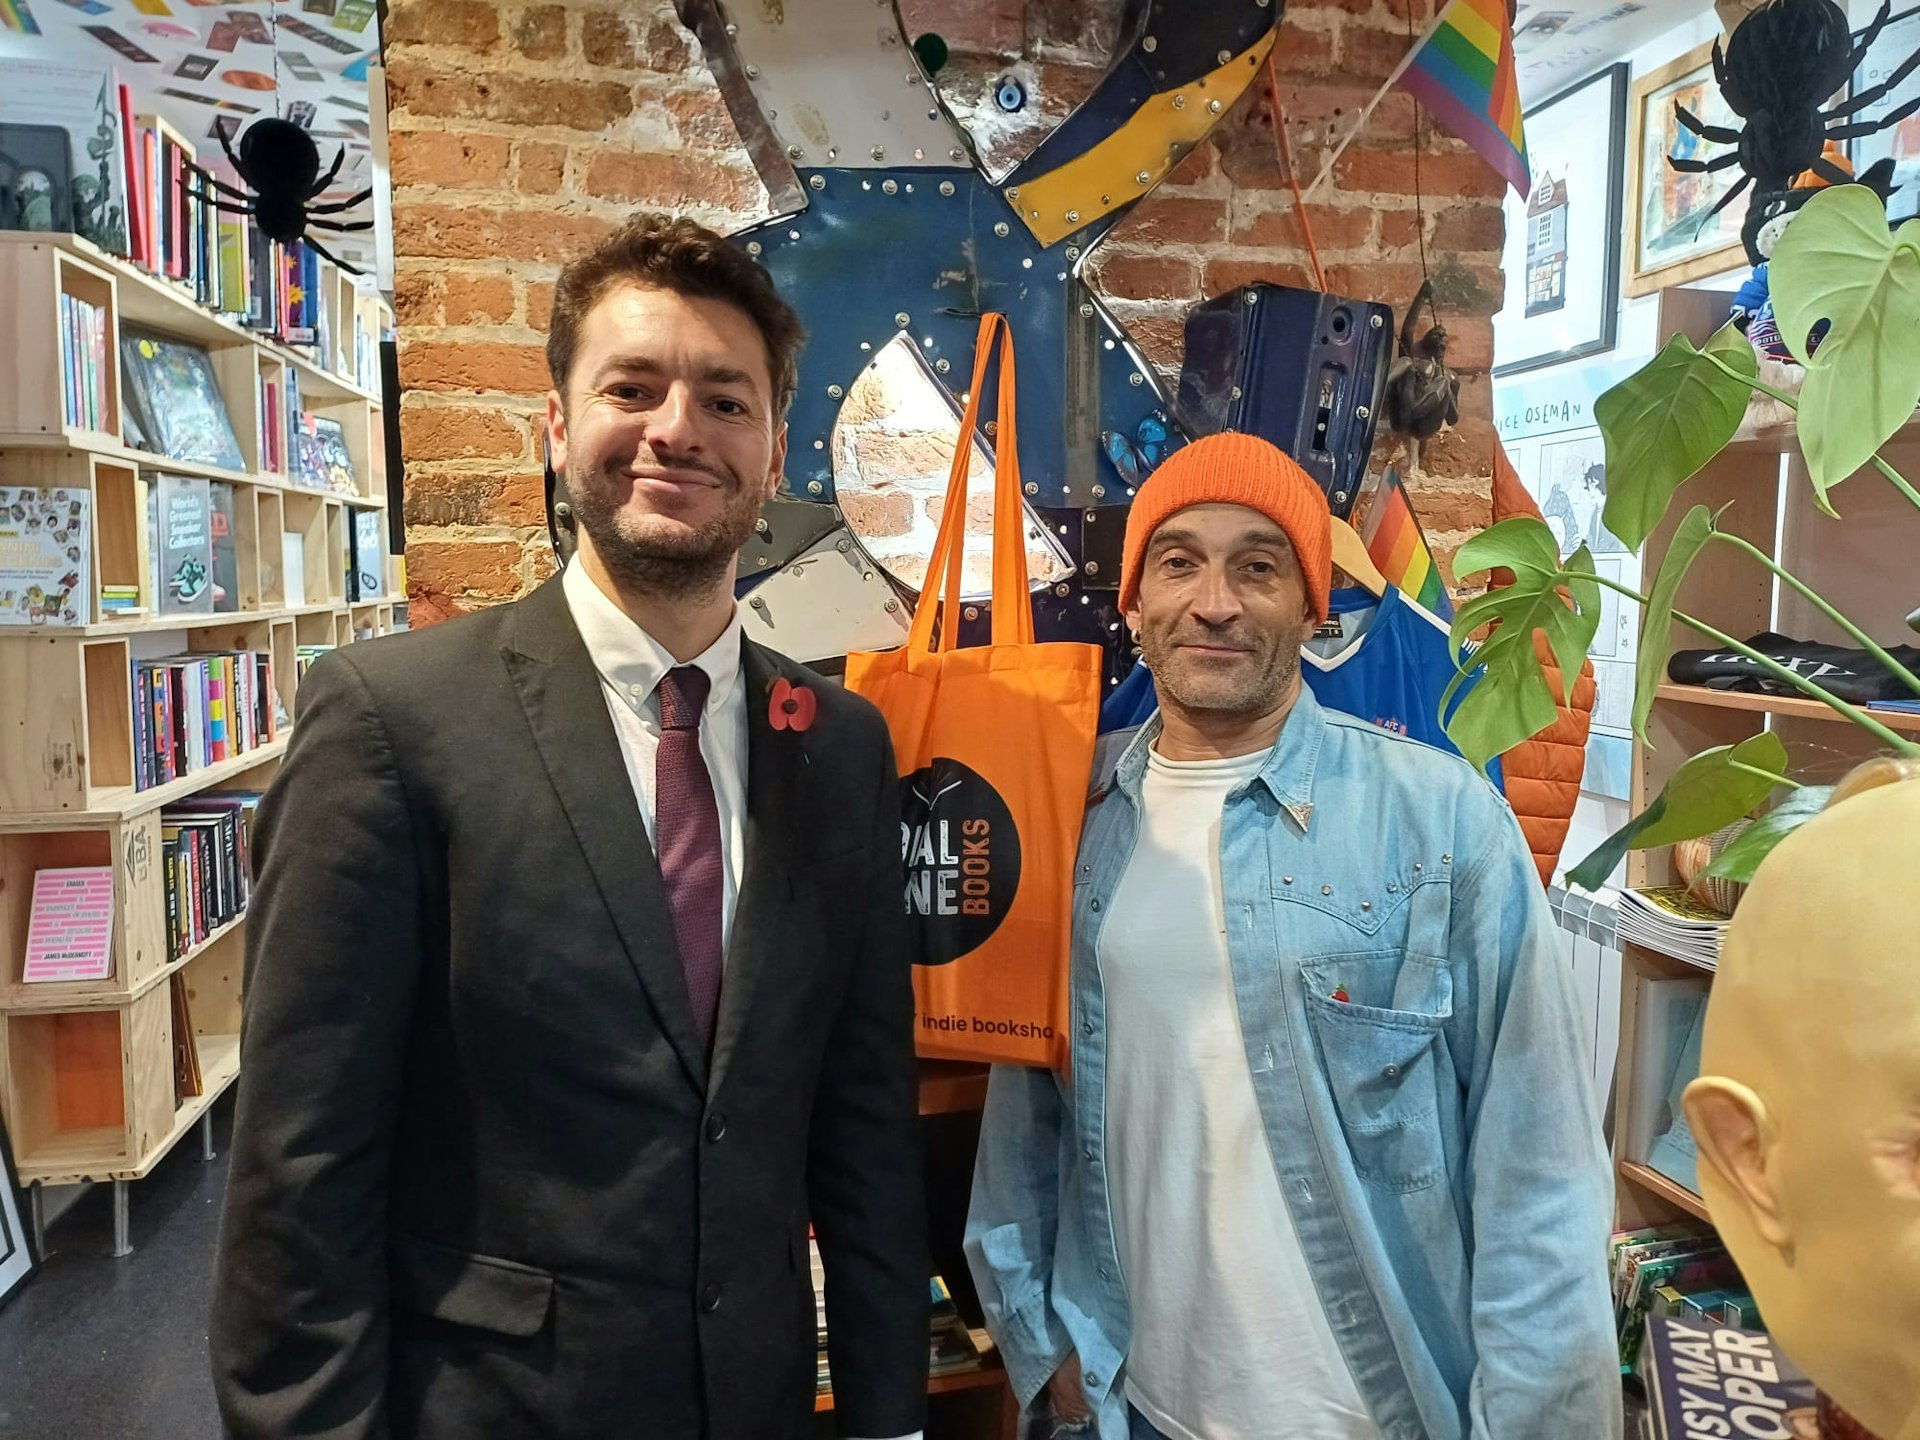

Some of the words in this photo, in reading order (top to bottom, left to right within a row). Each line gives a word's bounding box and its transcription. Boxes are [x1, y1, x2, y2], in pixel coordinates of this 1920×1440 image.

[1525, 400, 1580, 424] OSEMAN
[169, 508, 202, 523] Greatest
[962, 818, 991, 915] BOOKS
[922, 1012, 967, 1031] indie
[1665, 1320, 1721, 1390] MAY
